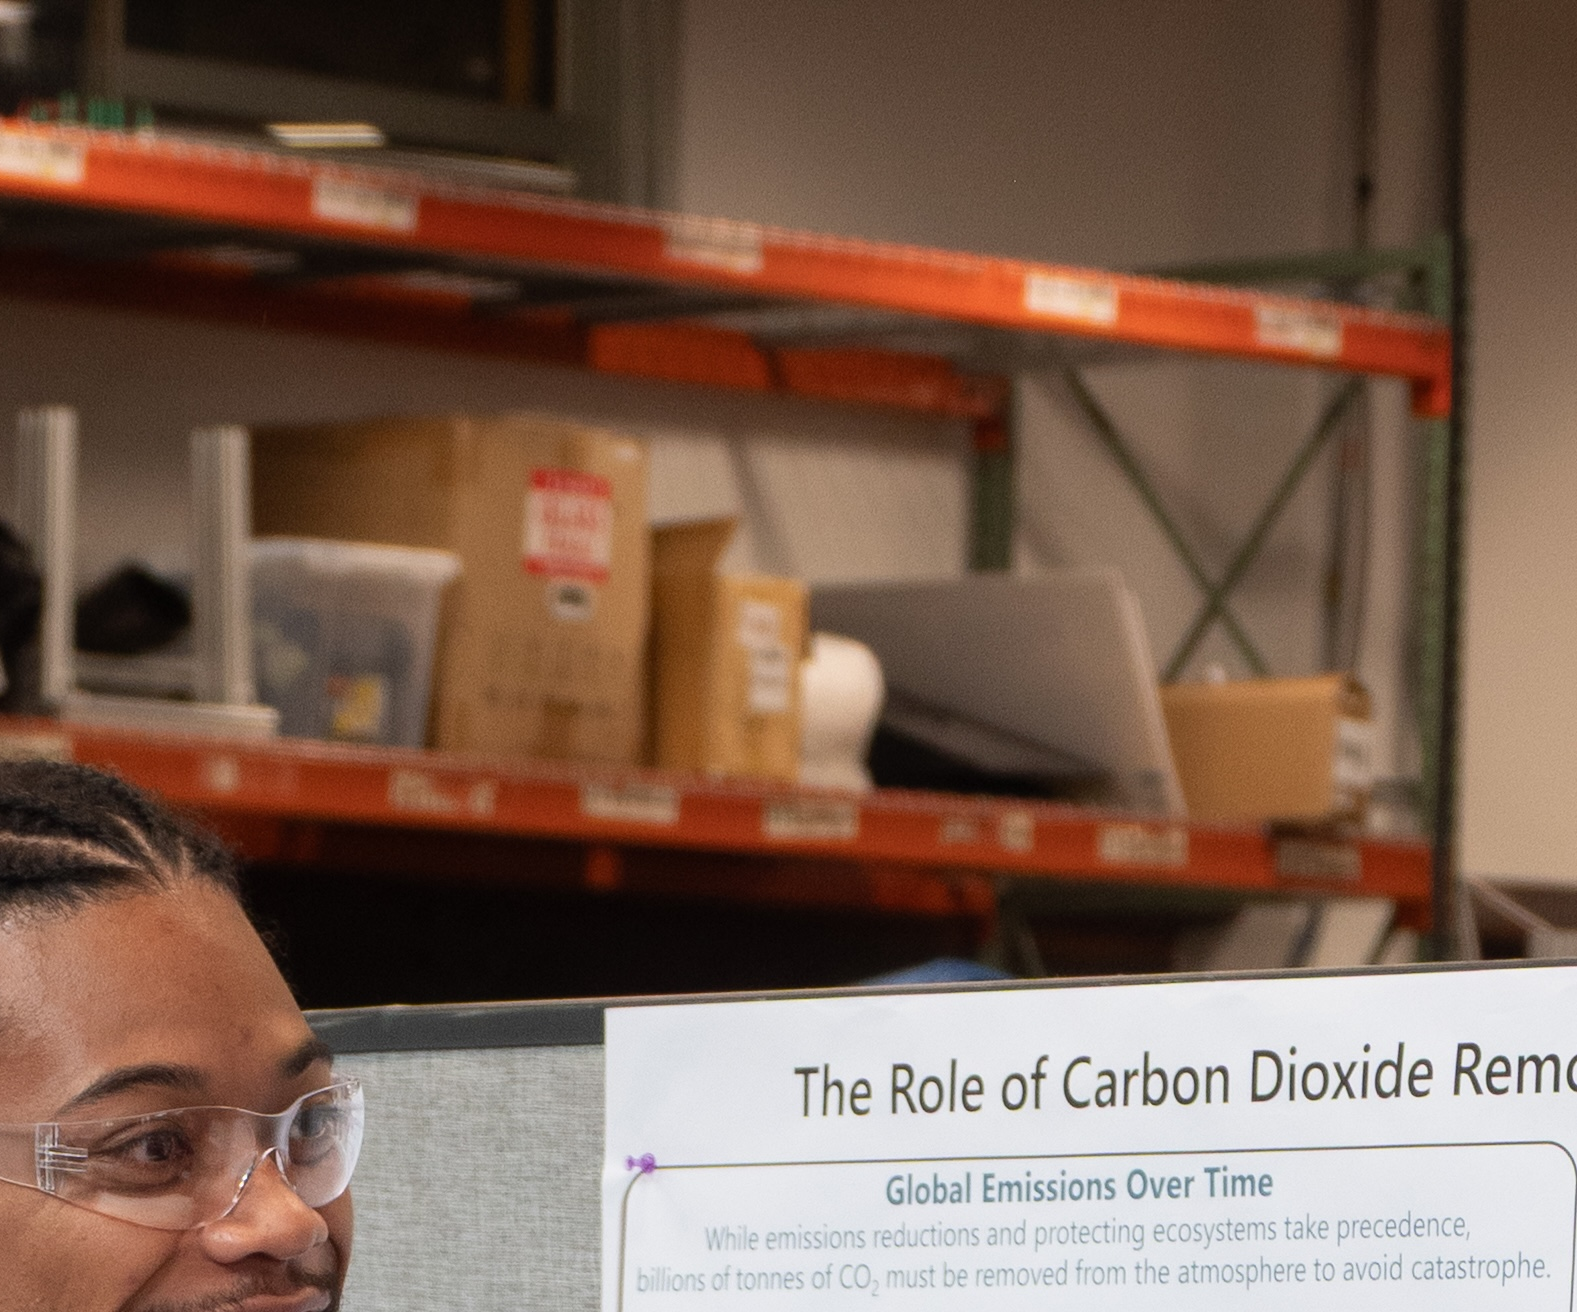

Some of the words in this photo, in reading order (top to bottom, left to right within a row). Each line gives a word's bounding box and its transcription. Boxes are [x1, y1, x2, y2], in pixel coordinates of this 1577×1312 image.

[794, 1065, 872, 1117] The
[891, 1059, 984, 1114] Role
[1001, 1055, 1047, 1111] of
[1061, 1051, 1230, 1110] Carbon
[1250, 1042, 1433, 1104] Dioxide
[886, 1172, 971, 1205] Global
[982, 1168, 1117, 1202] Emissions
[1126, 1167, 1196, 1200] Over
[1204, 1165, 1274, 1198] Time
[705, 1225, 759, 1251] While
[765, 1222, 867, 1250] emissions
[873, 1221, 980, 1249] reductions
[987, 1219, 1025, 1246] and
[1035, 1217, 1145, 1253] protecting
[1152, 1219, 1278, 1250] ecosystems
[1284, 1213, 1330, 1240] take
[1337, 1211, 1471, 1247] precedence,
[637, 1267, 706, 1293] billions
[711, 1265, 732, 1291] of
[736, 1265, 804, 1290] tonnes
[811, 1263, 833, 1290] of
[886, 1262, 936, 1288] must
[943, 1262, 968, 1287] be
[975, 1259, 1068, 1287] removed
[1075, 1258, 1126, 1286] from
[1134, 1258, 1170, 1285] the
[1178, 1256, 1306, 1290] atmosphere
[1313, 1260, 1335, 1282] to
[1342, 1254, 1404, 1281] avoid
[1412, 1251, 1552, 1286] catastrophe.
